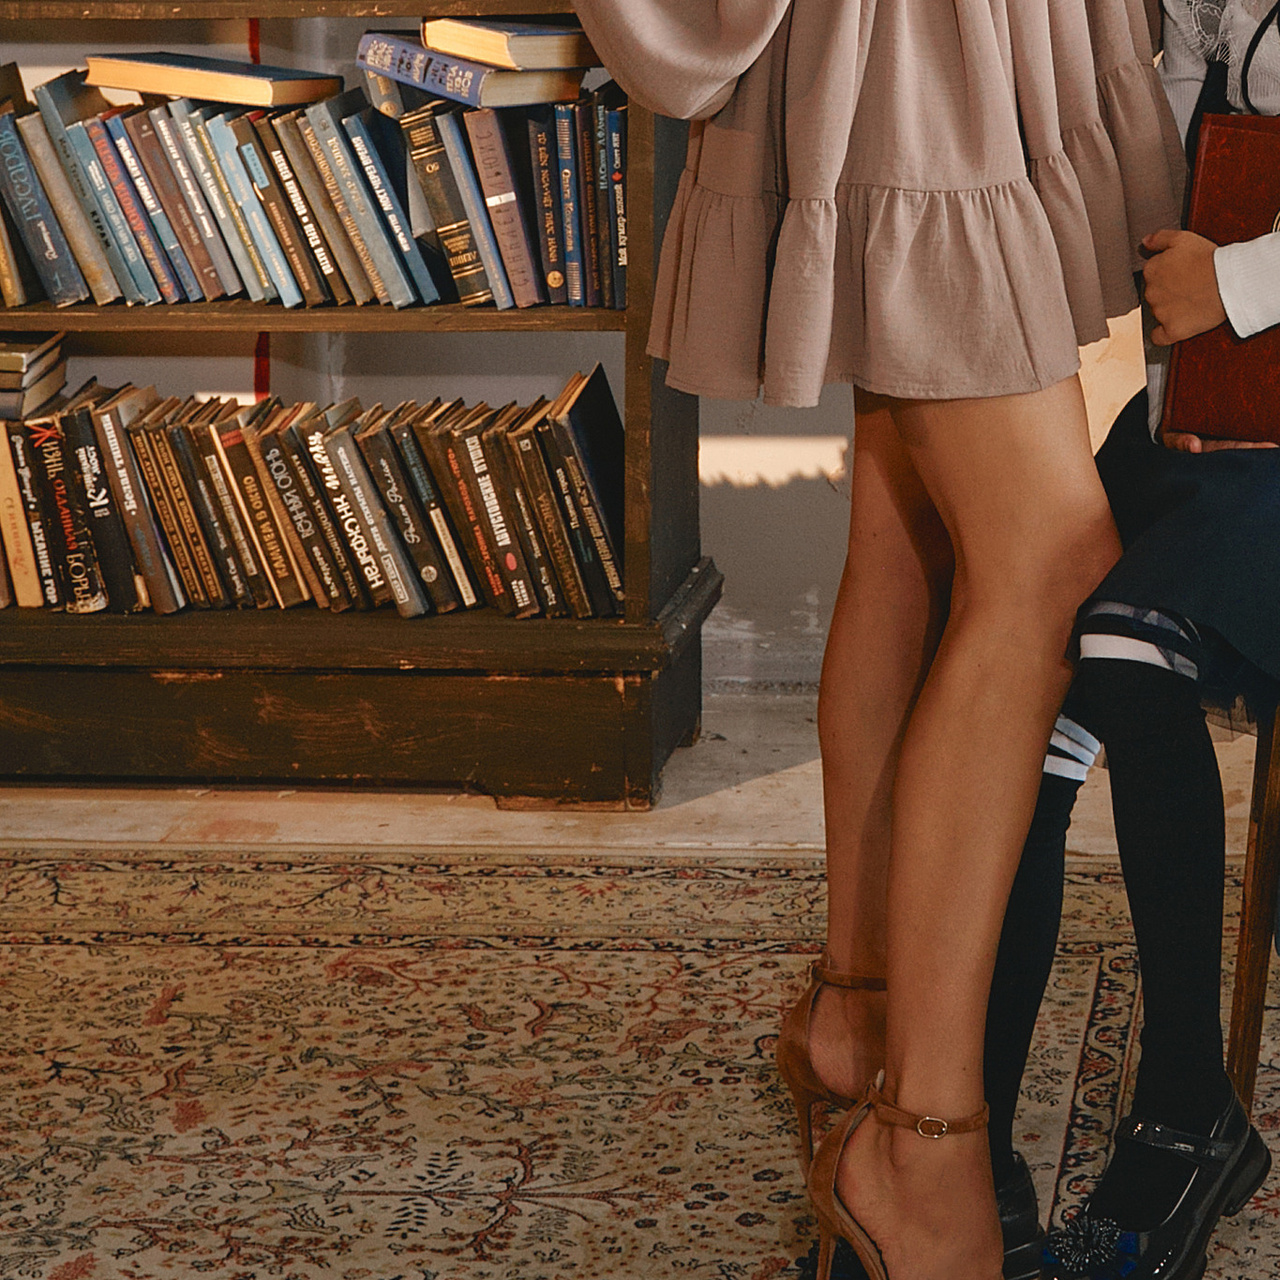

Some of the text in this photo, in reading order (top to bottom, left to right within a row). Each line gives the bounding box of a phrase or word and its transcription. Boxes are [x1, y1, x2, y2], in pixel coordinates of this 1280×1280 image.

[461, 71, 473, 98] НОВ
[90, 136, 123, 183] ЧЕСТИ
[349, 133, 394, 214] МОСТ ЧЕРЕЗ ВРЕМЯ
[88, 208, 113, 251] КУРАЖ
[111, 179, 148, 234] ДОРОГА
[617, 245, 632, 266] Мой
[83, 441, 103, 475] мост
[100, 410, 136, 513] Белая тишина
[336, 444, 357, 486] НАСТЕЖЬ
[171, 486, 183, 500] НА
[352, 483, 375, 527] ОТКРЫТЫ
[455, 477, 477, 523] ПАРОХОДА
[463, 433, 512, 548] АВГУСТОВСКИЕ ПУШКИ
[52, 477, 79, 551] ОТДАННАЯ
[176, 498, 197, 533] СТАРШЕ
[241, 473, 289, 579] КАМНЕМ В ОКНО
[311, 497, 348, 571] УСТОЙЧИВОСТЬ
[24, 508, 55, 578] ДЫХАНИЕ
[42, 575, 63, 605] ГОР
[332, 493, 385, 589] Ян Скрыган
[369, 524, 388, 554] ДВЕРИ
[470, 523, 491, 562] ХРОНИКА
